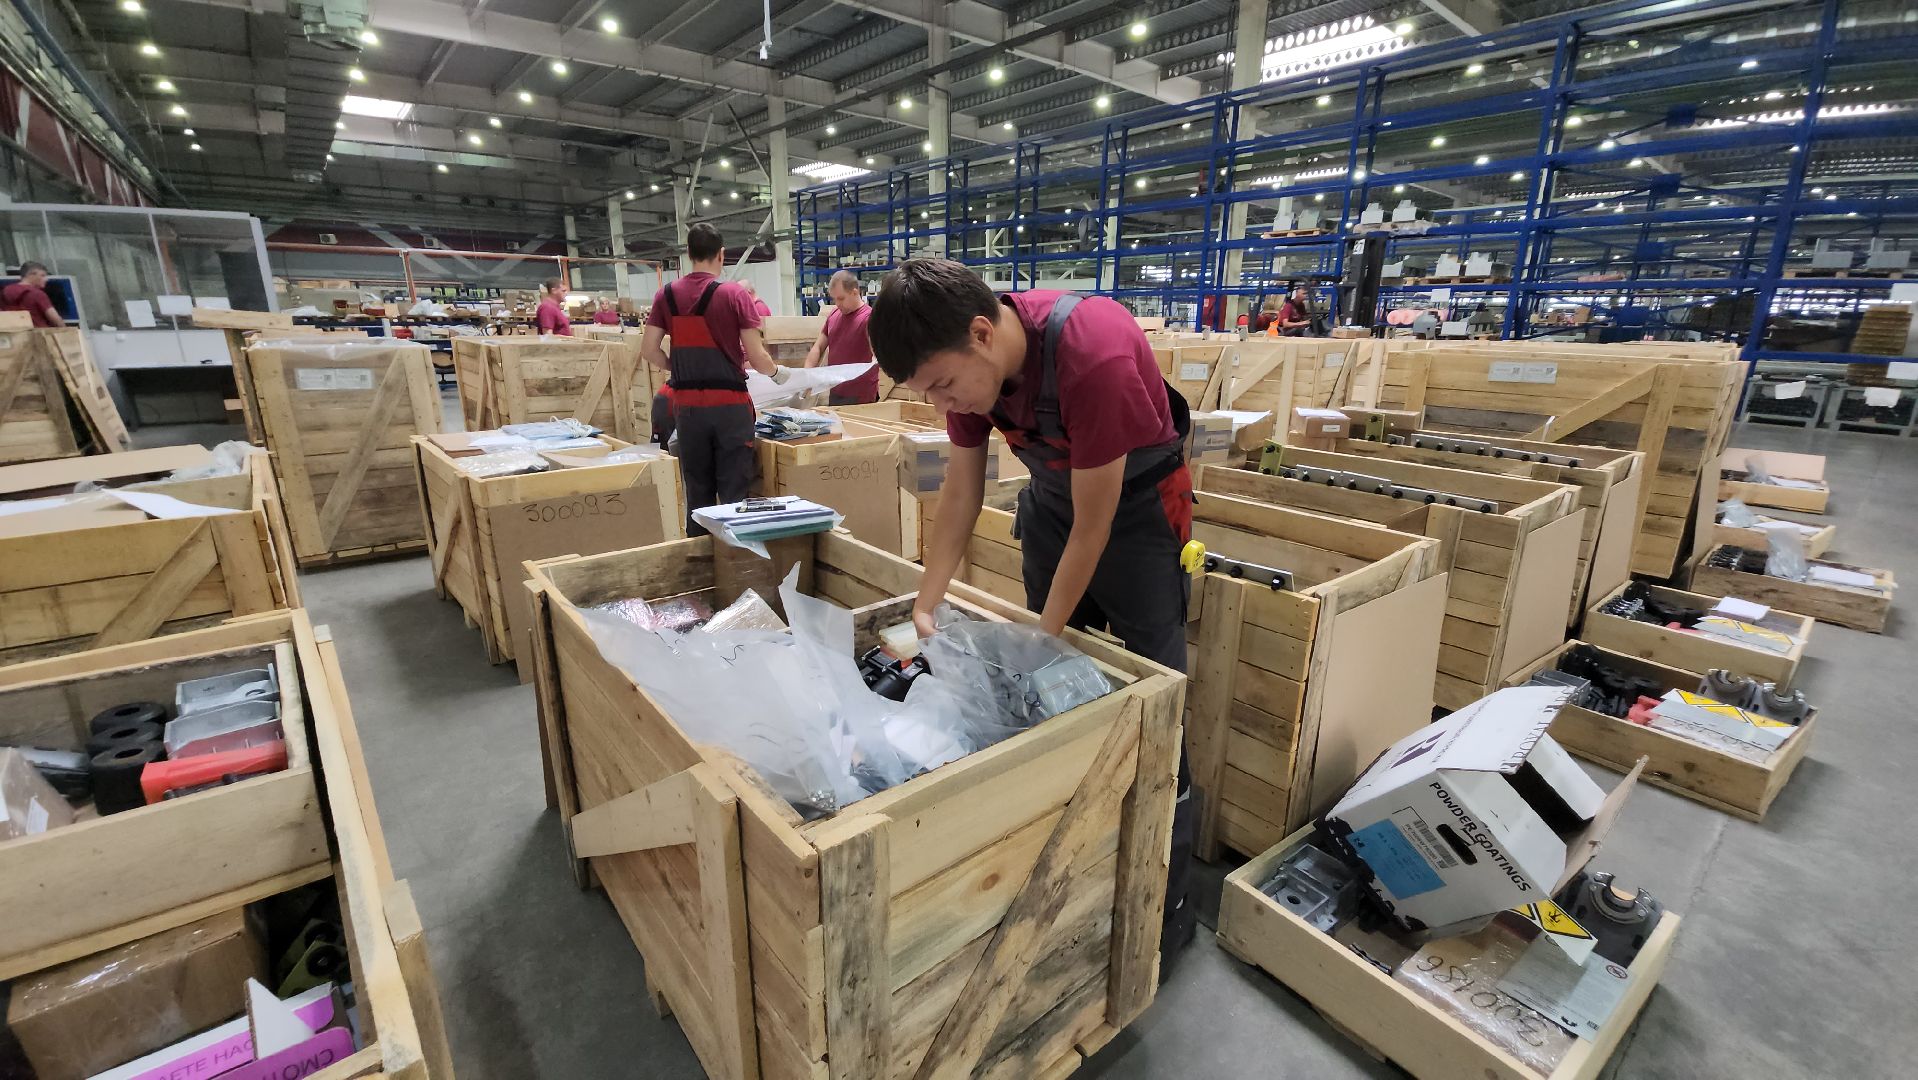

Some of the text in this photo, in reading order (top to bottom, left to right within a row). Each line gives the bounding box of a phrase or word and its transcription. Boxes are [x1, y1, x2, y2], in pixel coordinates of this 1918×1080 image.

[818, 459, 879, 483] 300094
[522, 493, 627, 522] 300093
[1429, 782, 1478, 832] POWDER
[1474, 833, 1532, 891] COATINGS
